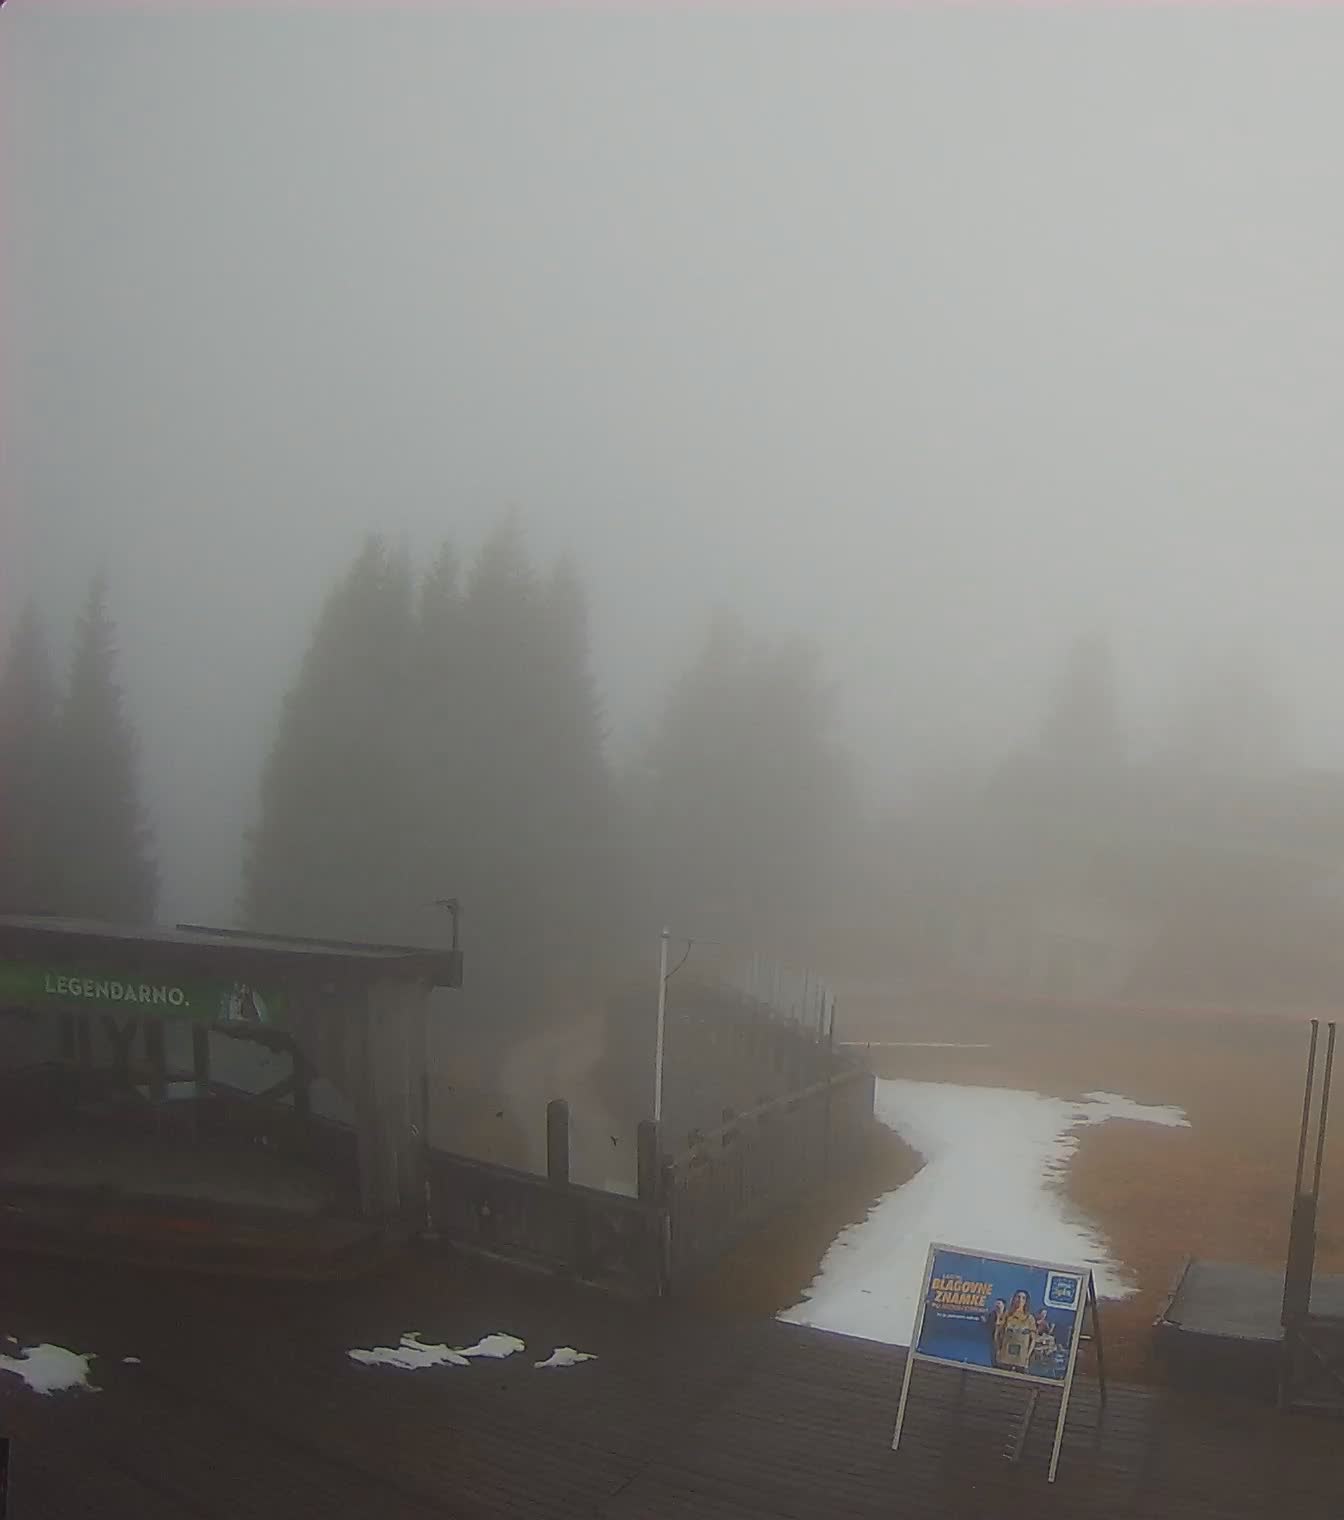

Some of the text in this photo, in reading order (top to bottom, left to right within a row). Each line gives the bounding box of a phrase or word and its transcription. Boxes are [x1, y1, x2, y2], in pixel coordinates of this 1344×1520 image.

[45, 974, 190, 1007] LEGENDARNO.
[931, 1278, 993, 1295] BLAGOVNE
[934, 1290, 986, 1307] ZNAMKE
